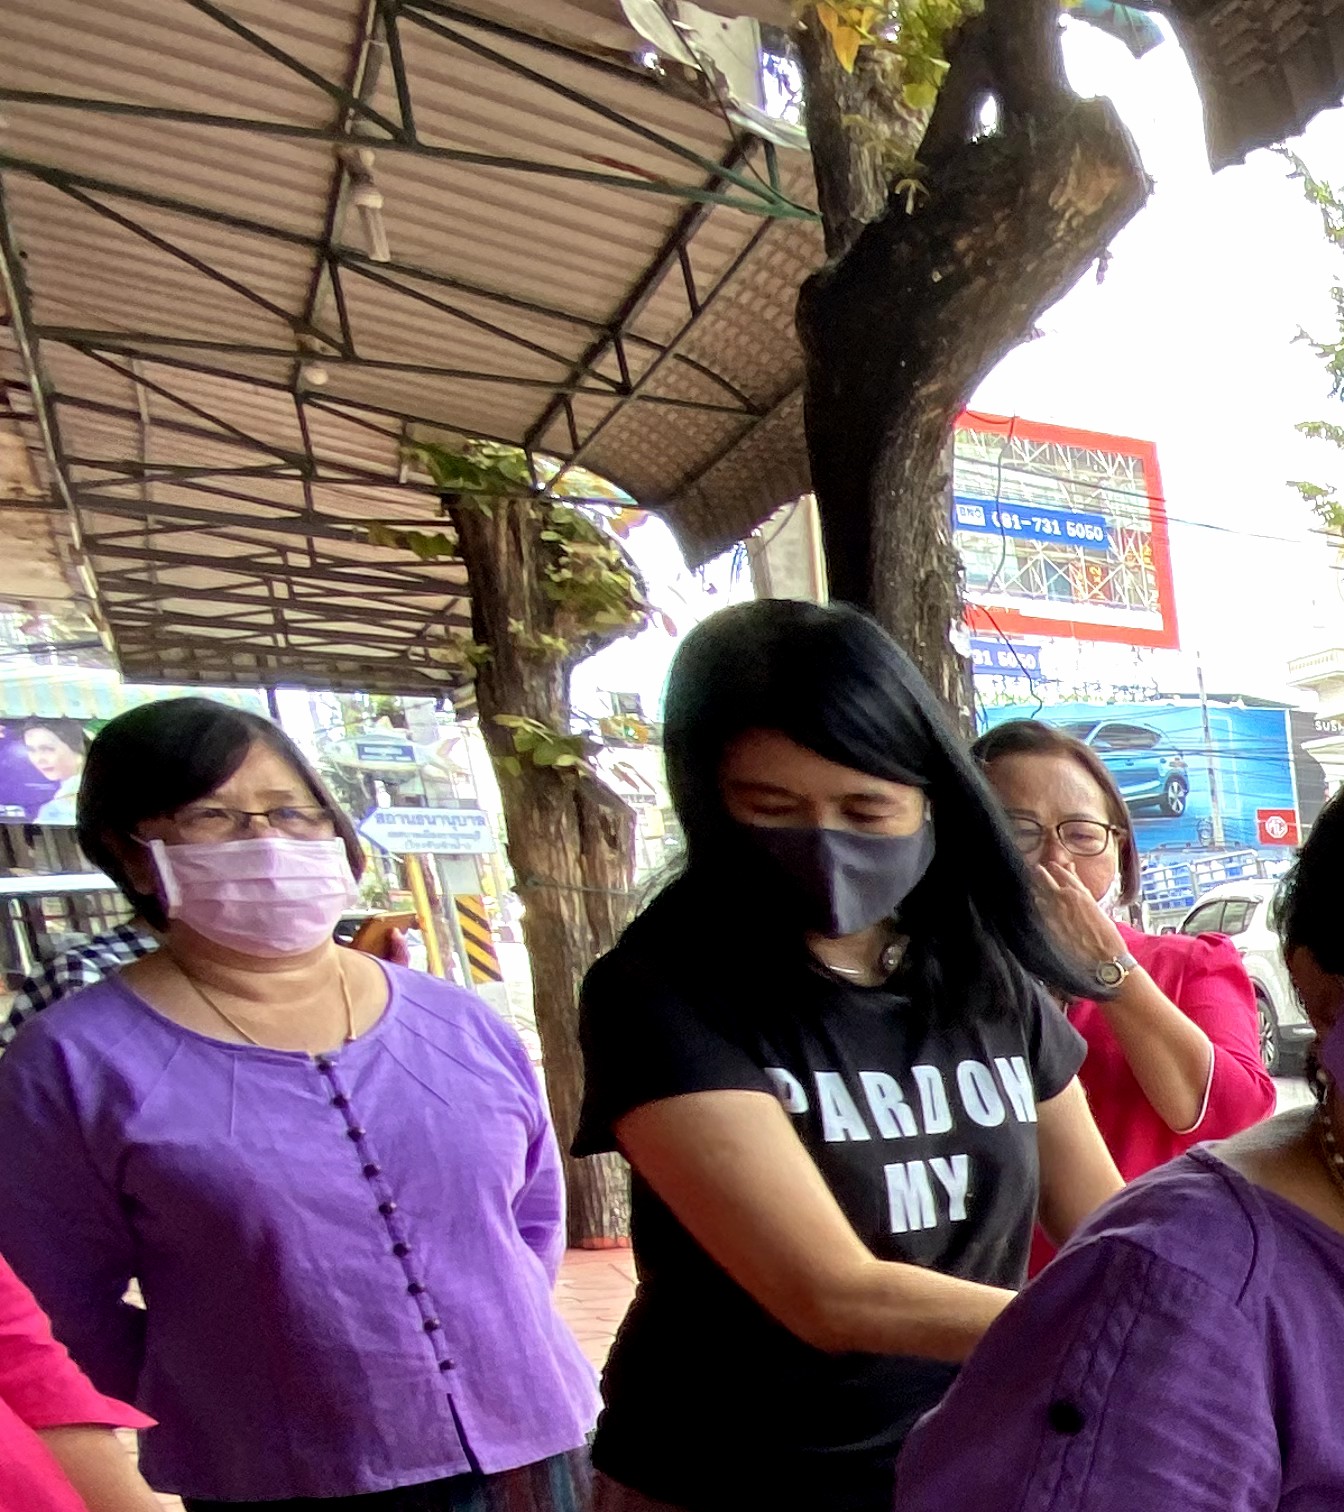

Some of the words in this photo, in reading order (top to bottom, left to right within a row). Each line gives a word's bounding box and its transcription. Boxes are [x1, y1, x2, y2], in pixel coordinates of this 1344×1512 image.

[972, 649, 993, 666] 31
[764, 1055, 1038, 1143] PARDON
[883, 1153, 969, 1234] MY
